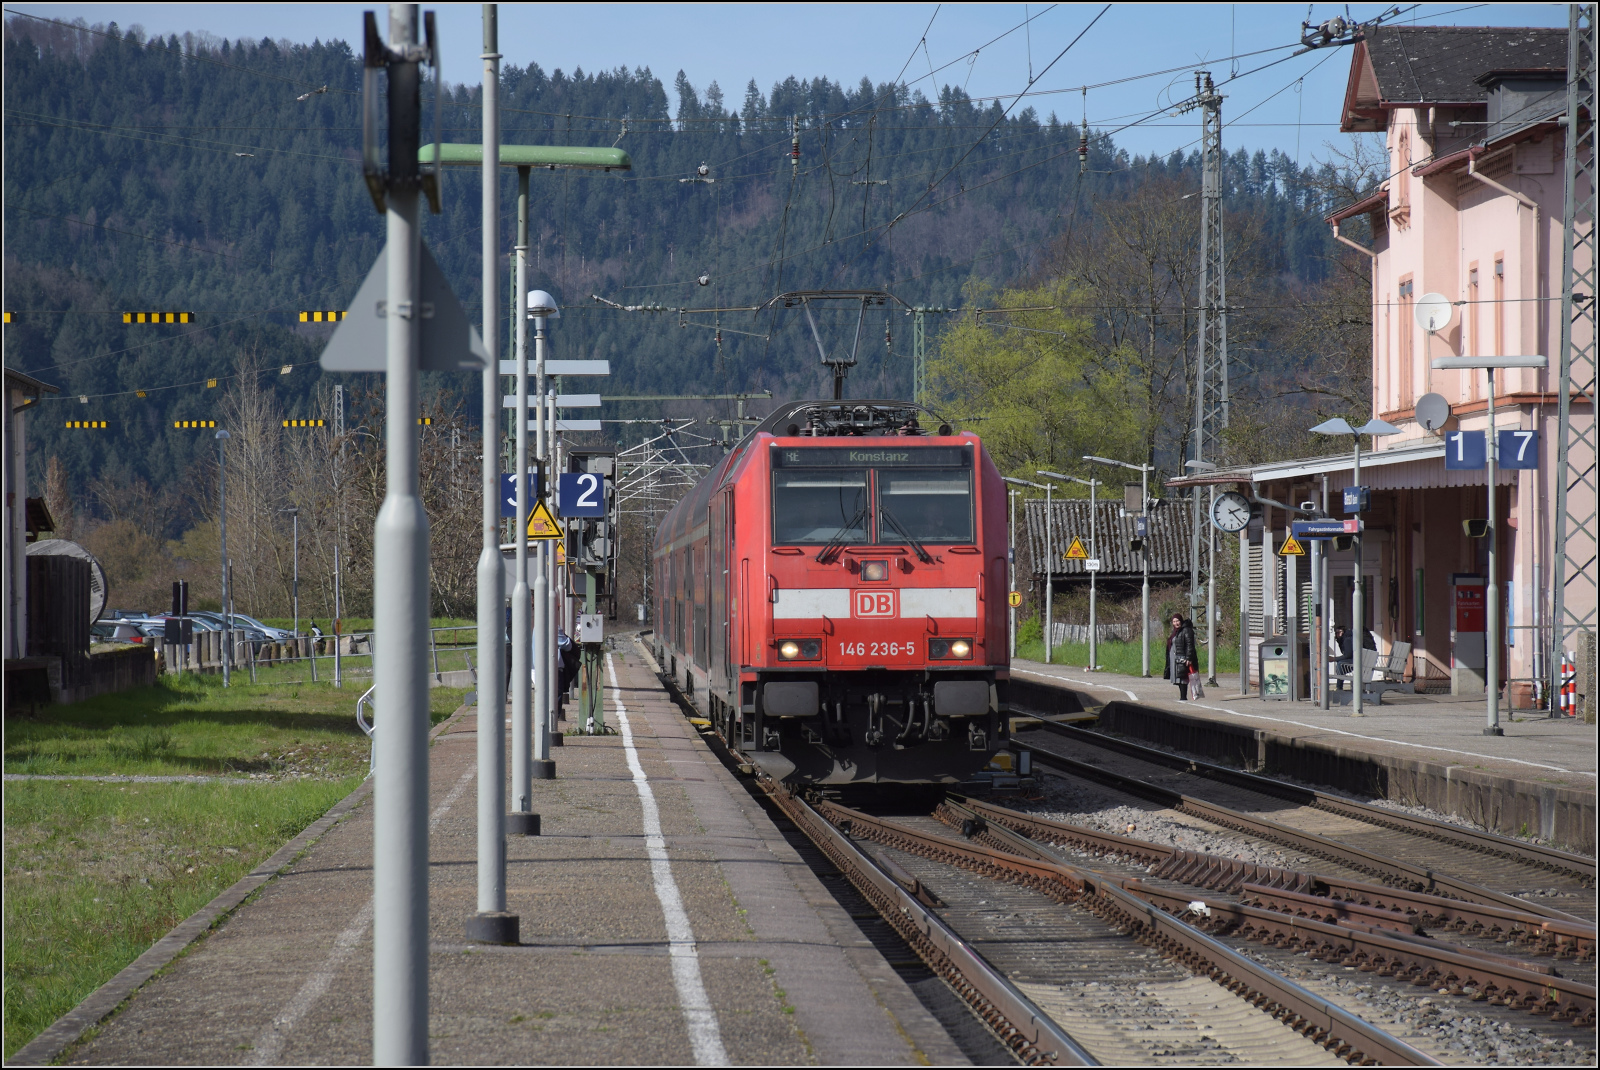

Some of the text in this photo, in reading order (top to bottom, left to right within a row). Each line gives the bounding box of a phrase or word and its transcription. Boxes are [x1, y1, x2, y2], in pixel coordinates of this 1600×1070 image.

[849, 451, 909, 462] Konstanz
[1450, 431, 1464, 462] 1
[1513, 431, 1533, 462] 7
[576, 473, 598, 507] 2
[859, 594, 891, 614] DB
[839, 641, 915, 656] 146 236-5
